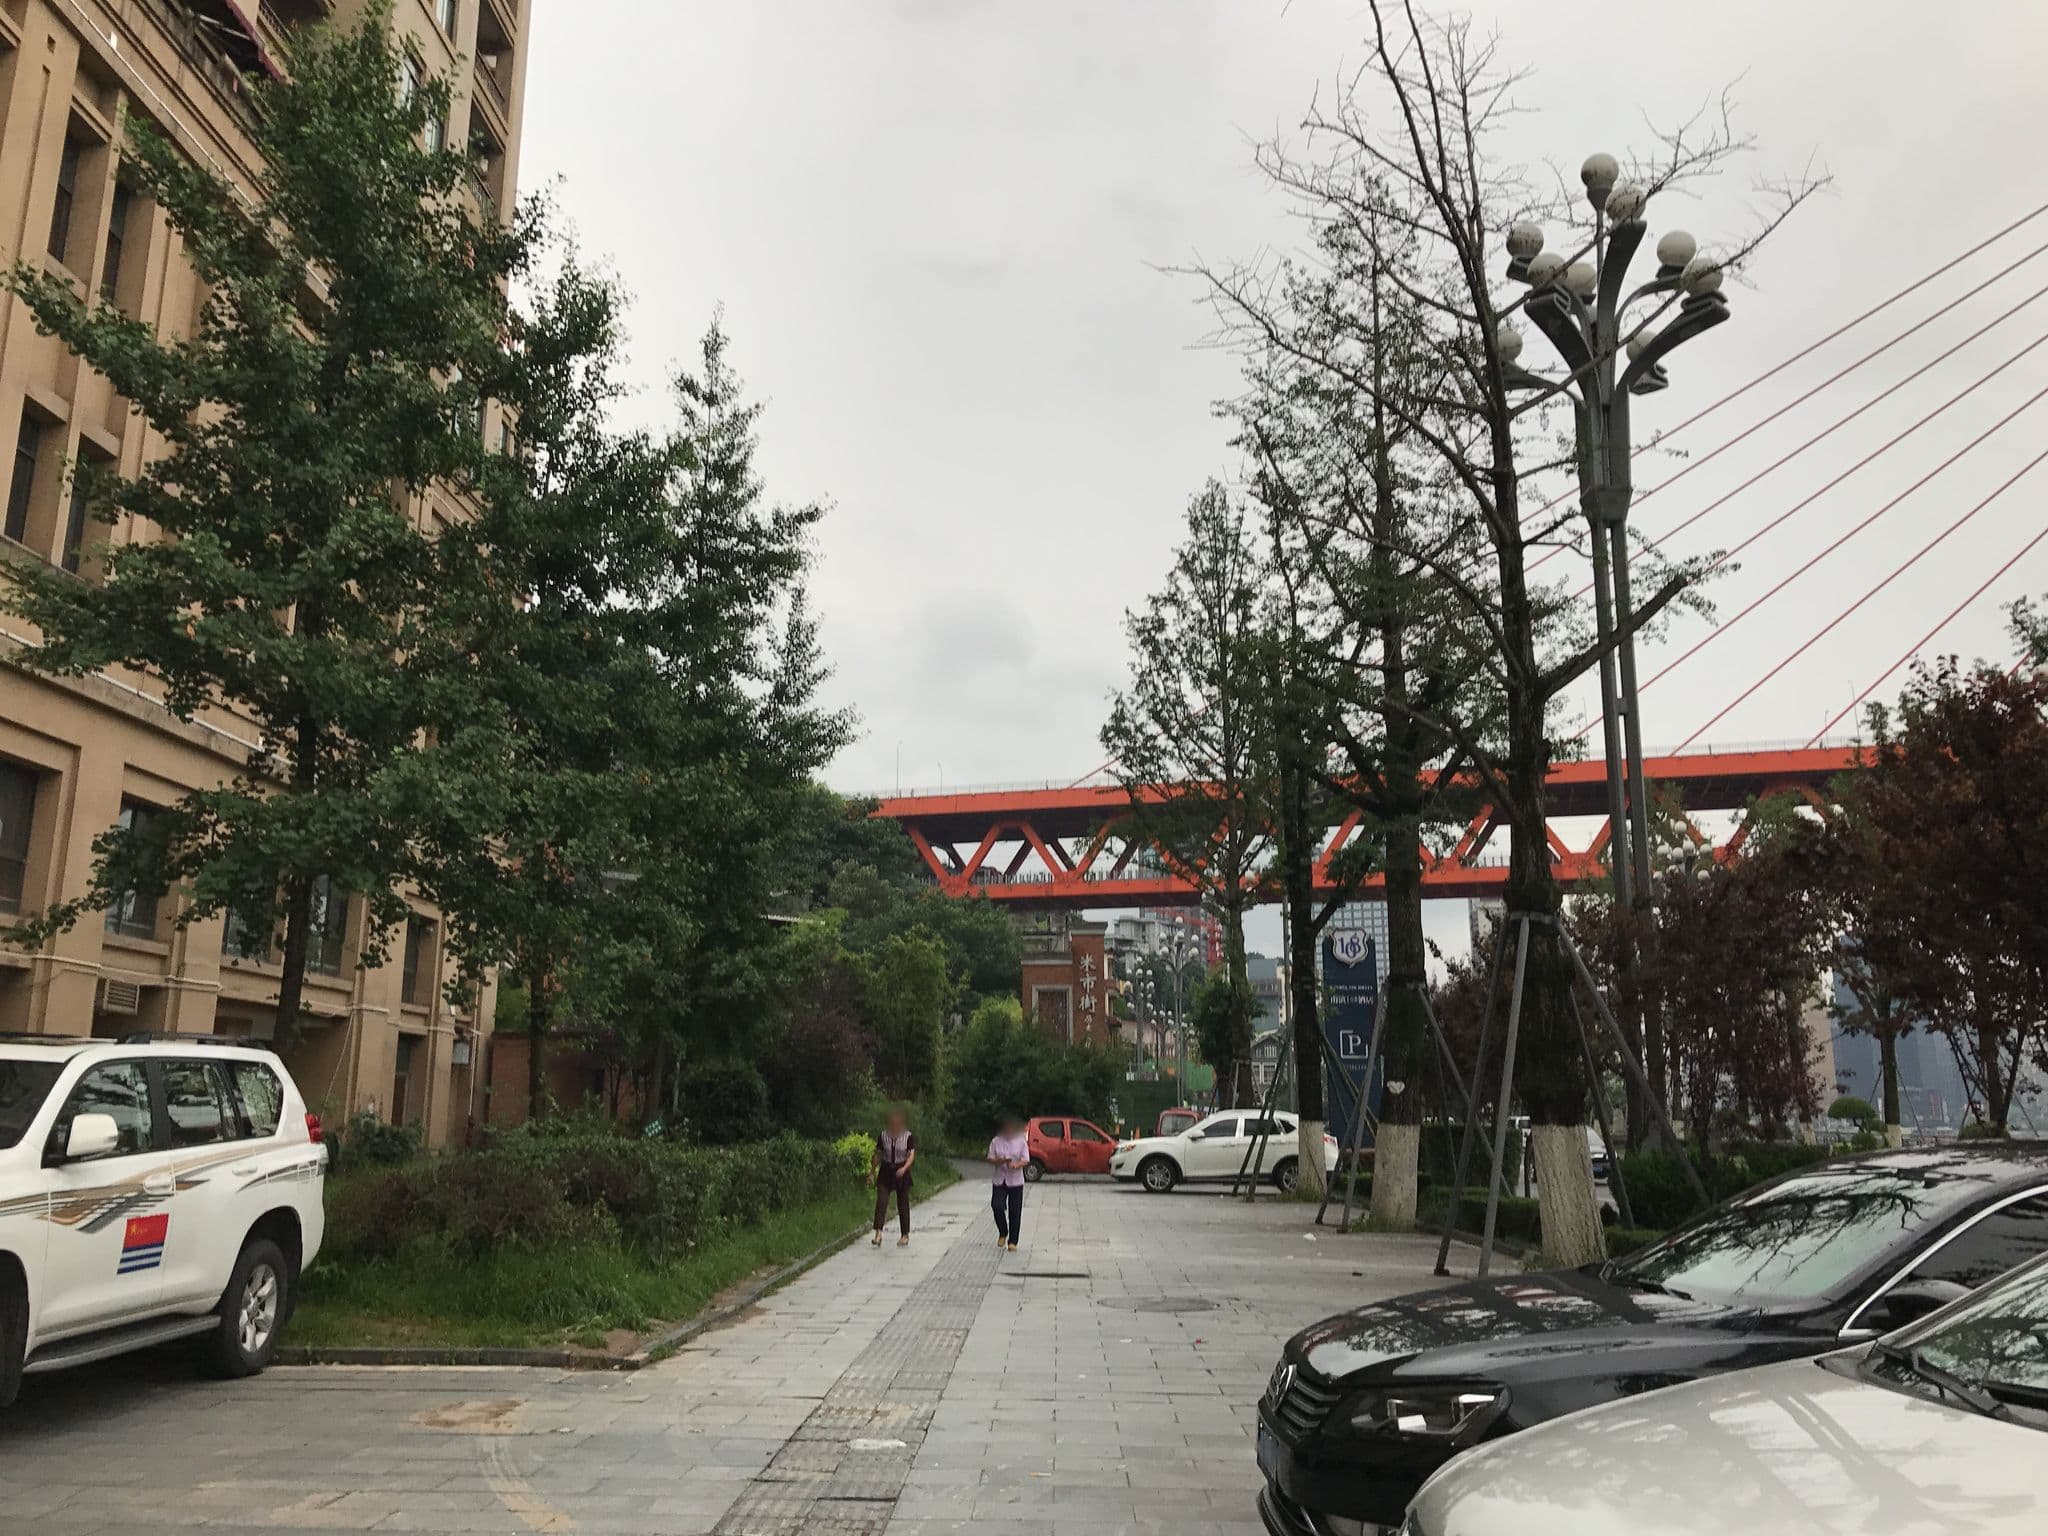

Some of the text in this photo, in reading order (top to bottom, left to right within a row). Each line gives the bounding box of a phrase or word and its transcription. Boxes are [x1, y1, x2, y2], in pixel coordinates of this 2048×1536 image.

[1338, 932, 1362, 959] 108
[1079, 953, 1097, 1013] 米市街
[1347, 1034, 1362, 1054] P
